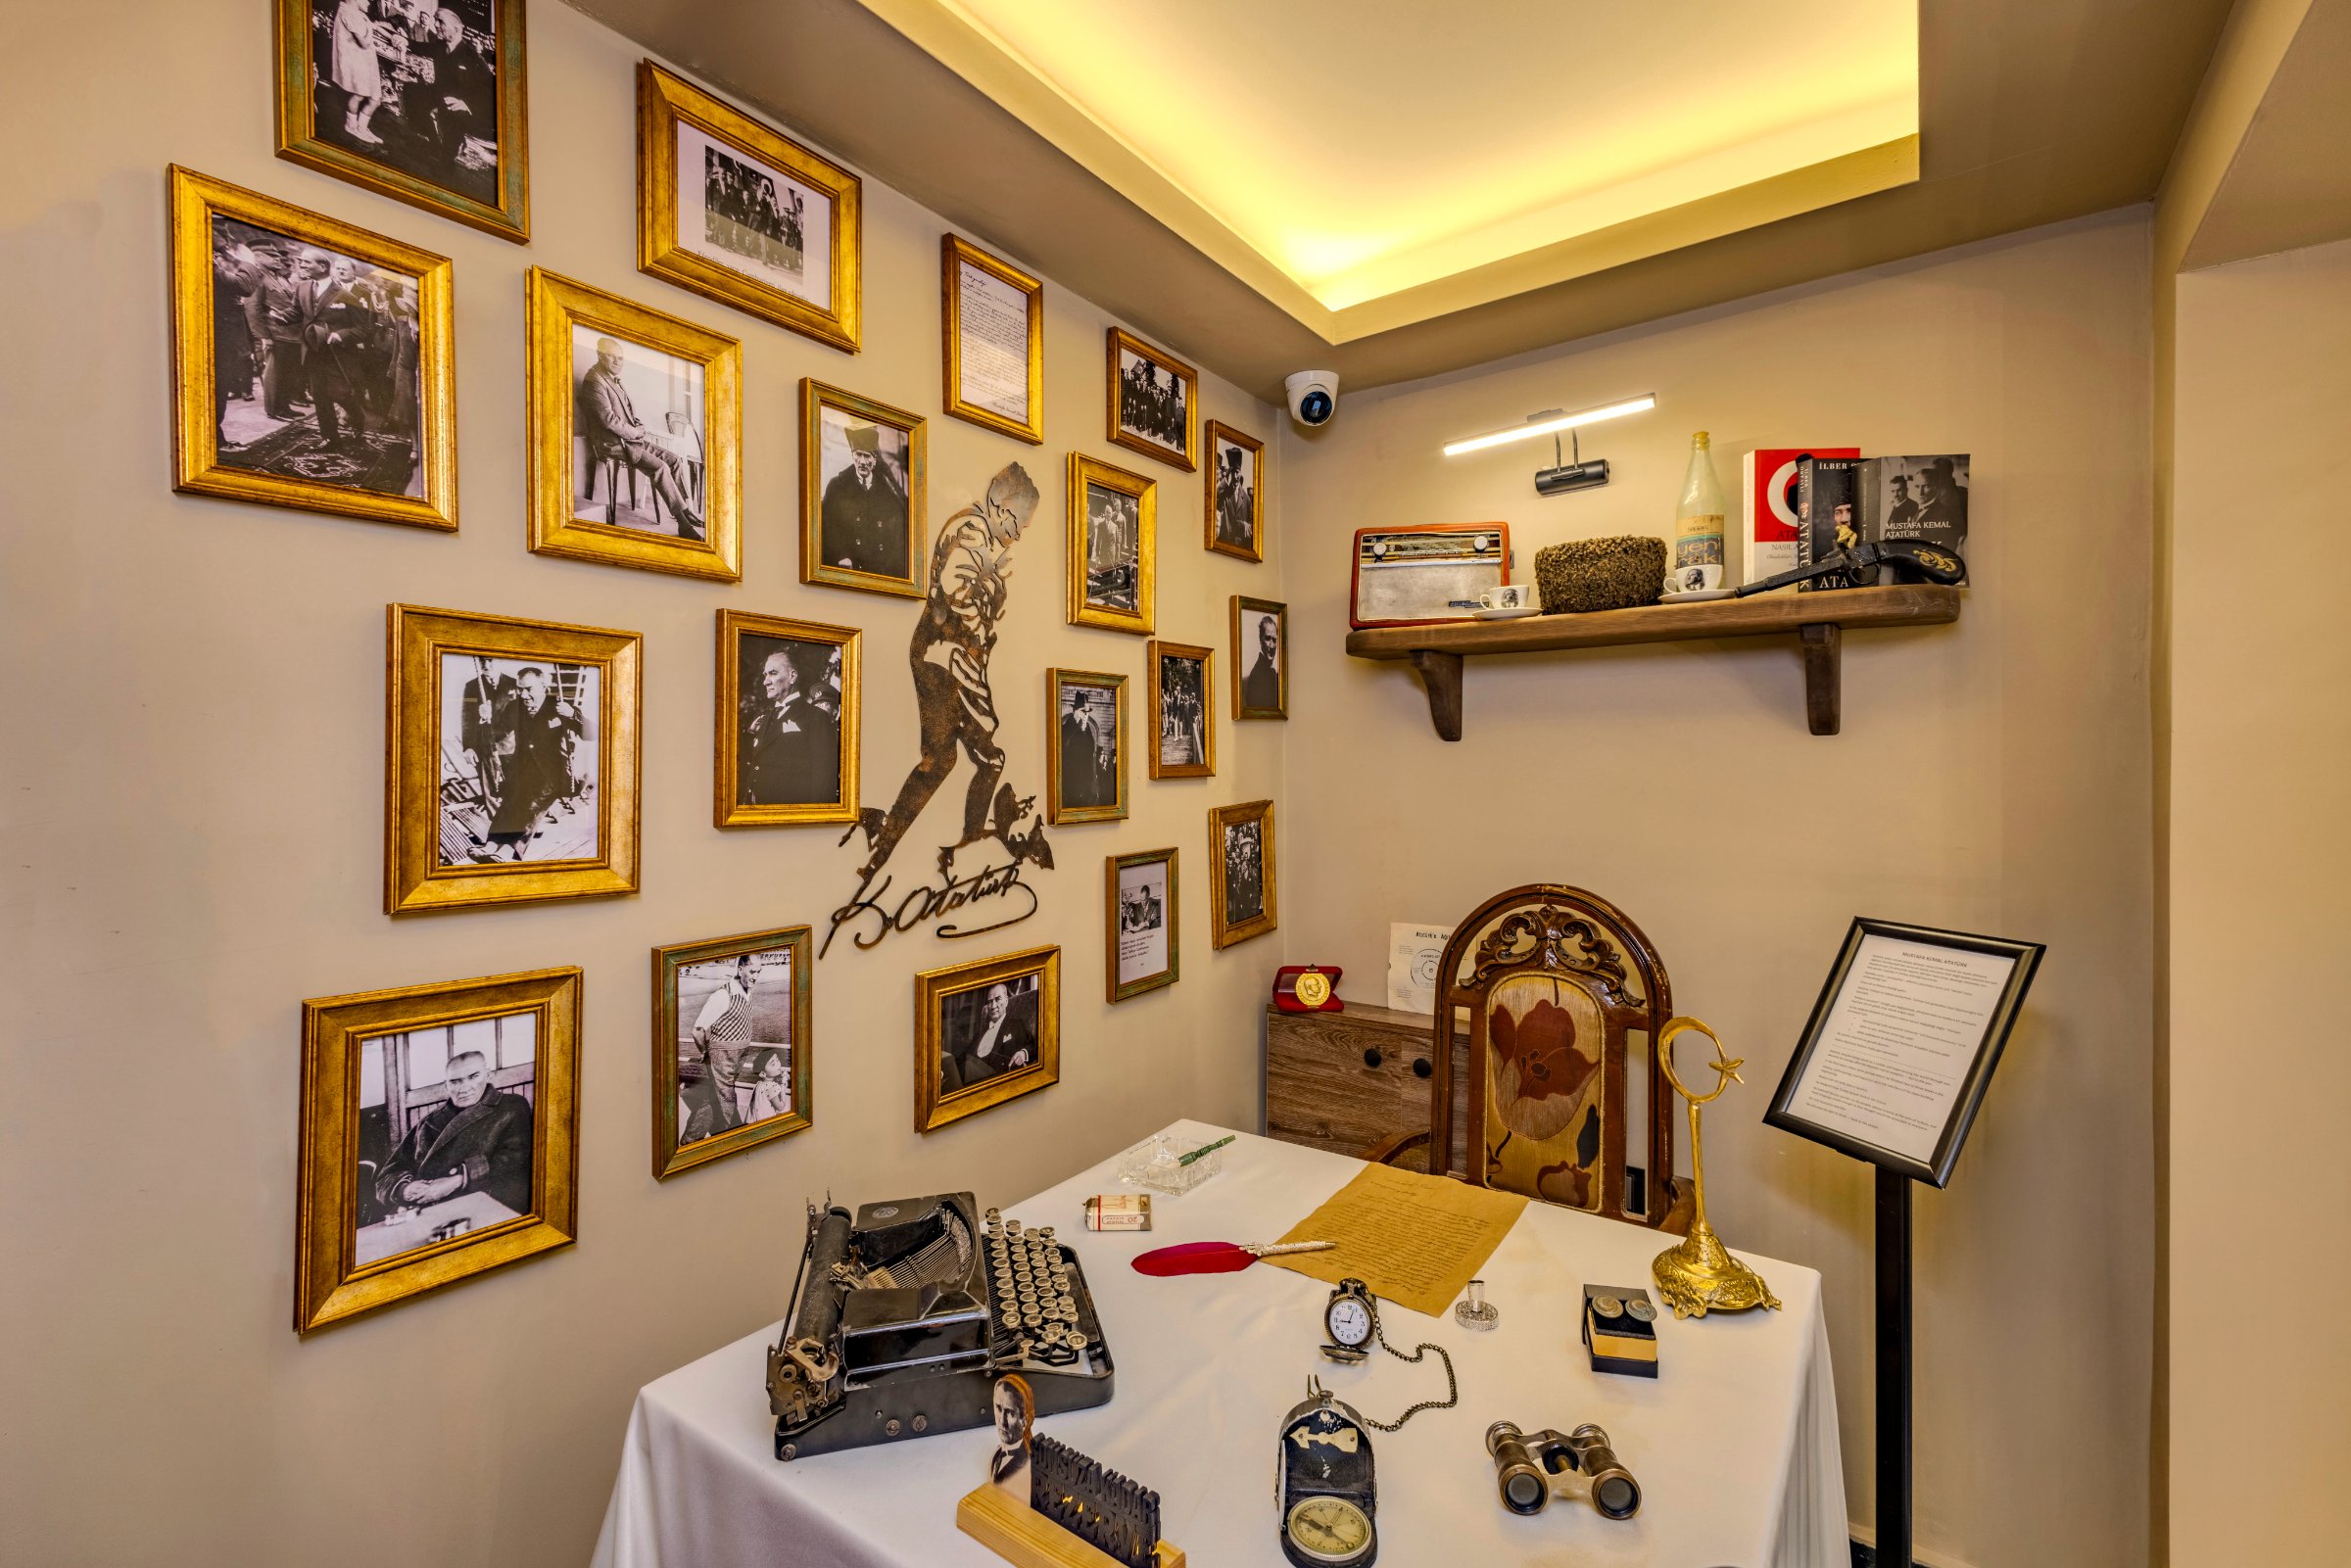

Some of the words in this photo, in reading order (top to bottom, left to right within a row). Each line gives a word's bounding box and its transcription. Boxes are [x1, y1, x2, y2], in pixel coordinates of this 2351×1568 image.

[1819, 461, 1847, 470] İLBER
[1799, 521, 1811, 590] ATATÜK
[1819, 576, 1849, 589] ATA
